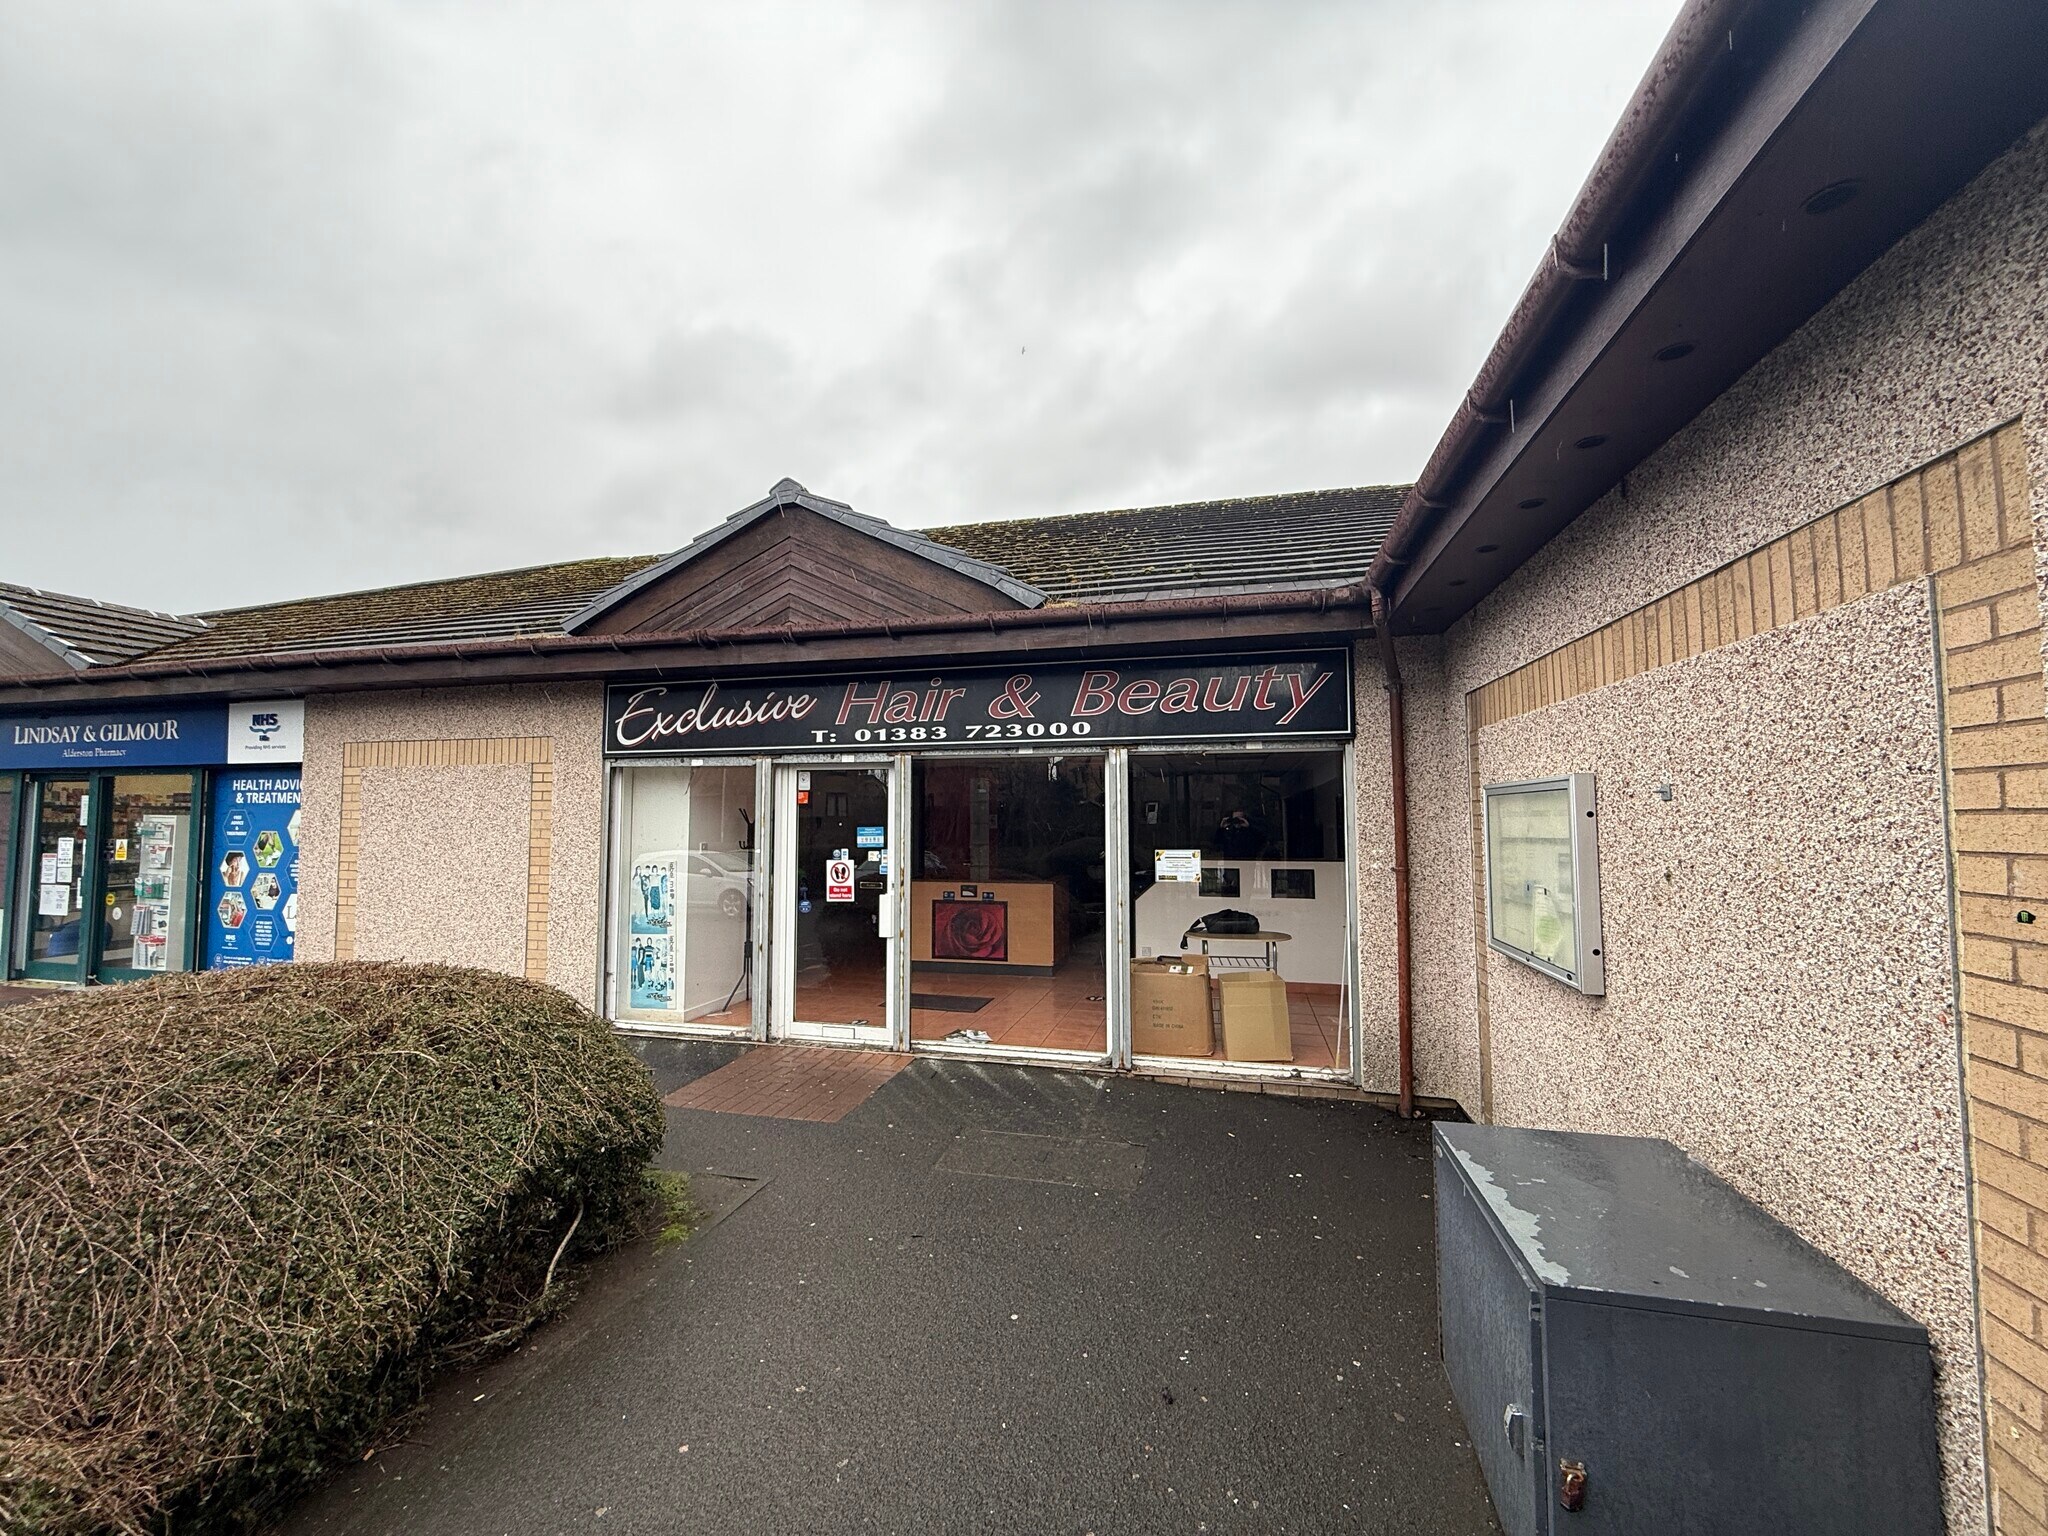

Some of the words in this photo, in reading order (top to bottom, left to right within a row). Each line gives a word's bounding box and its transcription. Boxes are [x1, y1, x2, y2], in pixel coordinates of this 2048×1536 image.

[615, 683, 818, 748] Exclusive
[835, 677, 967, 725] Hair
[988, 674, 1042, 719] &
[1070, 665, 1333, 726] Beauty
[252, 713, 278, 726] NHS
[14, 726, 80, 744] LINDSAY
[83, 725, 97, 743] &
[100, 719, 180, 742] GILMOUR
[811, 729, 837, 743] T:
[854, 726, 948, 742] 01383
[965, 721, 1092, 739] 723000
[62, 749, 93, 758] Alderston
[95, 748, 127, 758] Pharmacy
[233, 779, 272, 791] HEALTH
[236, 792, 244, 804] &
